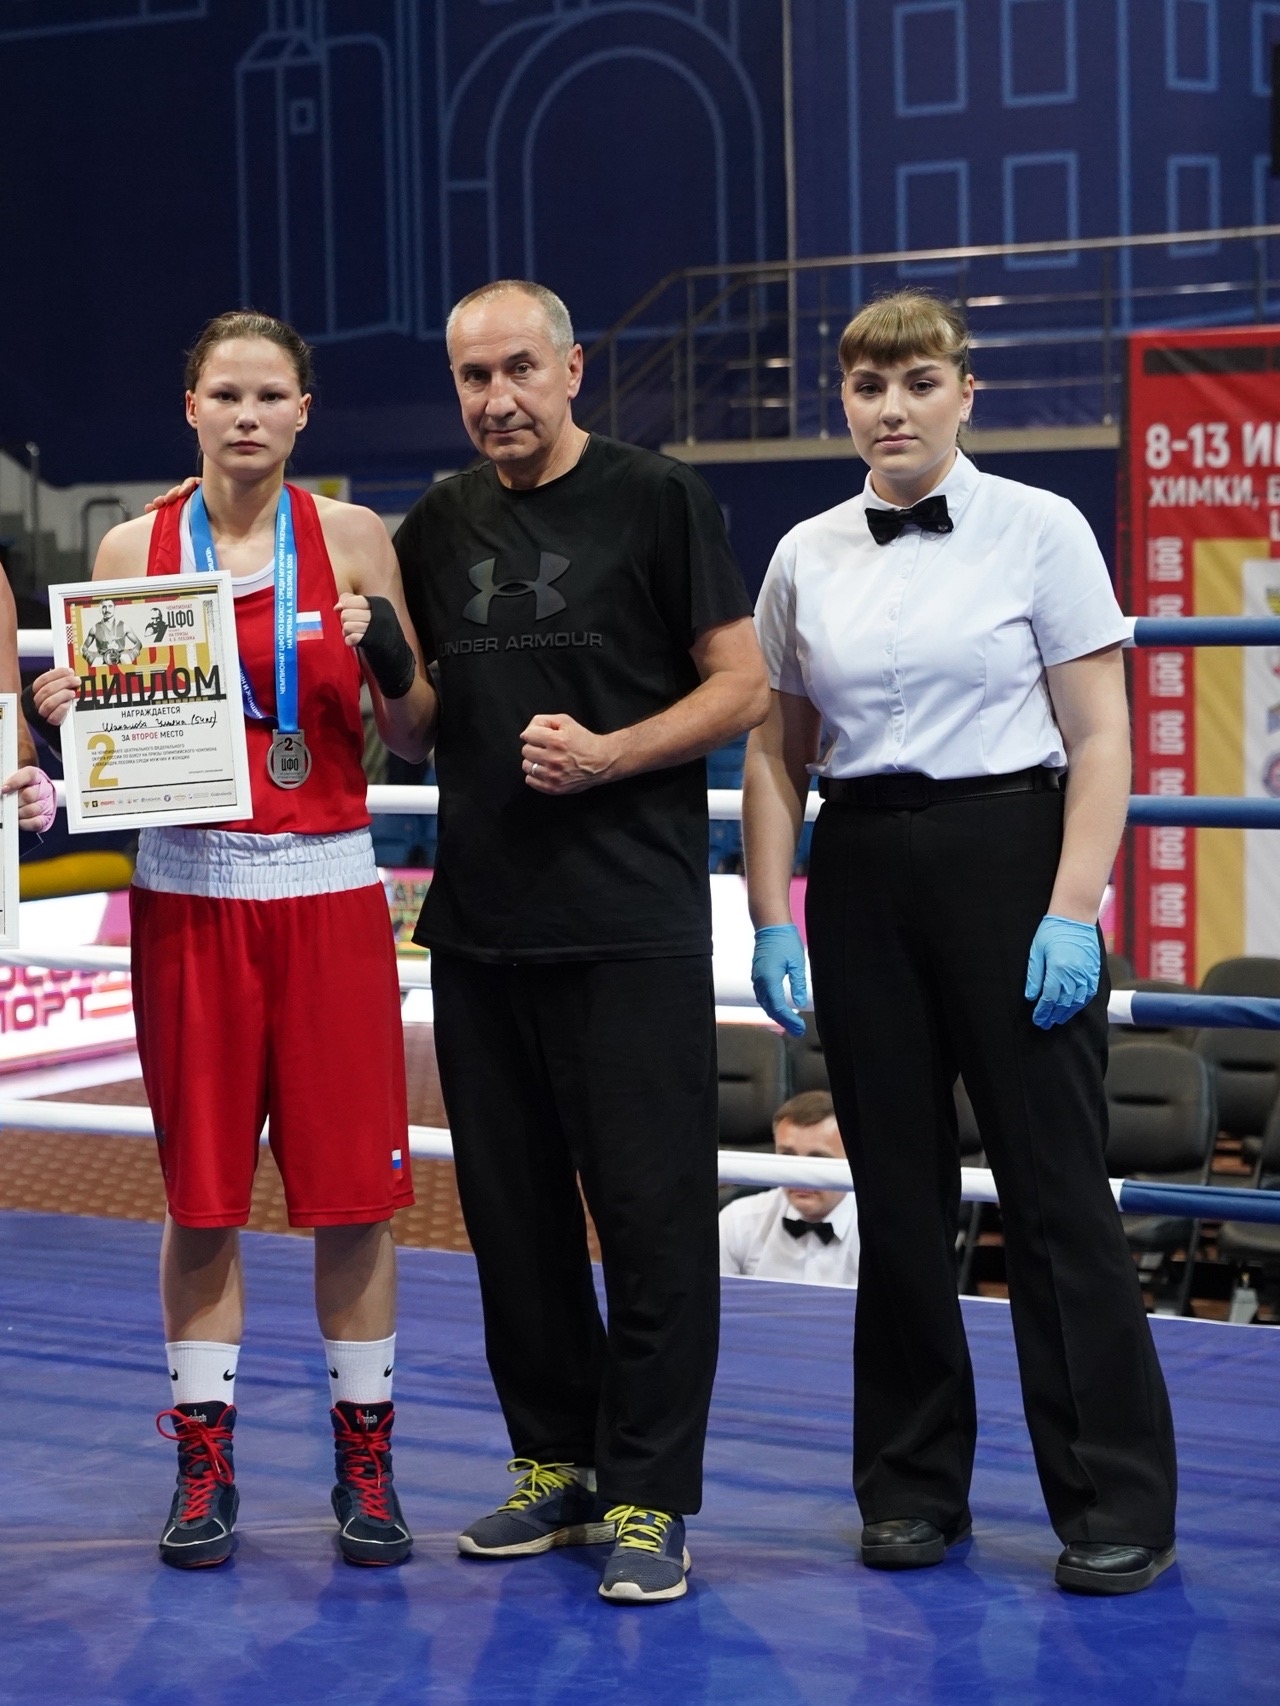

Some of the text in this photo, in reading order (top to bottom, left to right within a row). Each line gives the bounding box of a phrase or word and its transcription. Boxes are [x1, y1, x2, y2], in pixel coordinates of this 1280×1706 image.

[1146, 422, 1230, 469] 8-13
[1149, 474, 1260, 510] ХИМКИ,
[278, 578, 286, 600] СРЕДИ
[167, 609, 194, 628] ЦФО
[278, 624, 285, 634] ПО
[278, 635, 286, 651] ЦФО
[287, 638, 293, 649] НА
[440, 631, 603, 656] UNDER ARMOUR
[76, 665, 223, 709] ДИПЛОМ
[121, 706, 180, 718] НАГРАЖДАЕТСЯ
[121, 730, 184, 742] ЗА ВТОРОЕ МЕСТО
[284, 737, 293, 751] 2
[87, 733, 119, 789] 2
[281, 757, 299, 771] ЦФО
